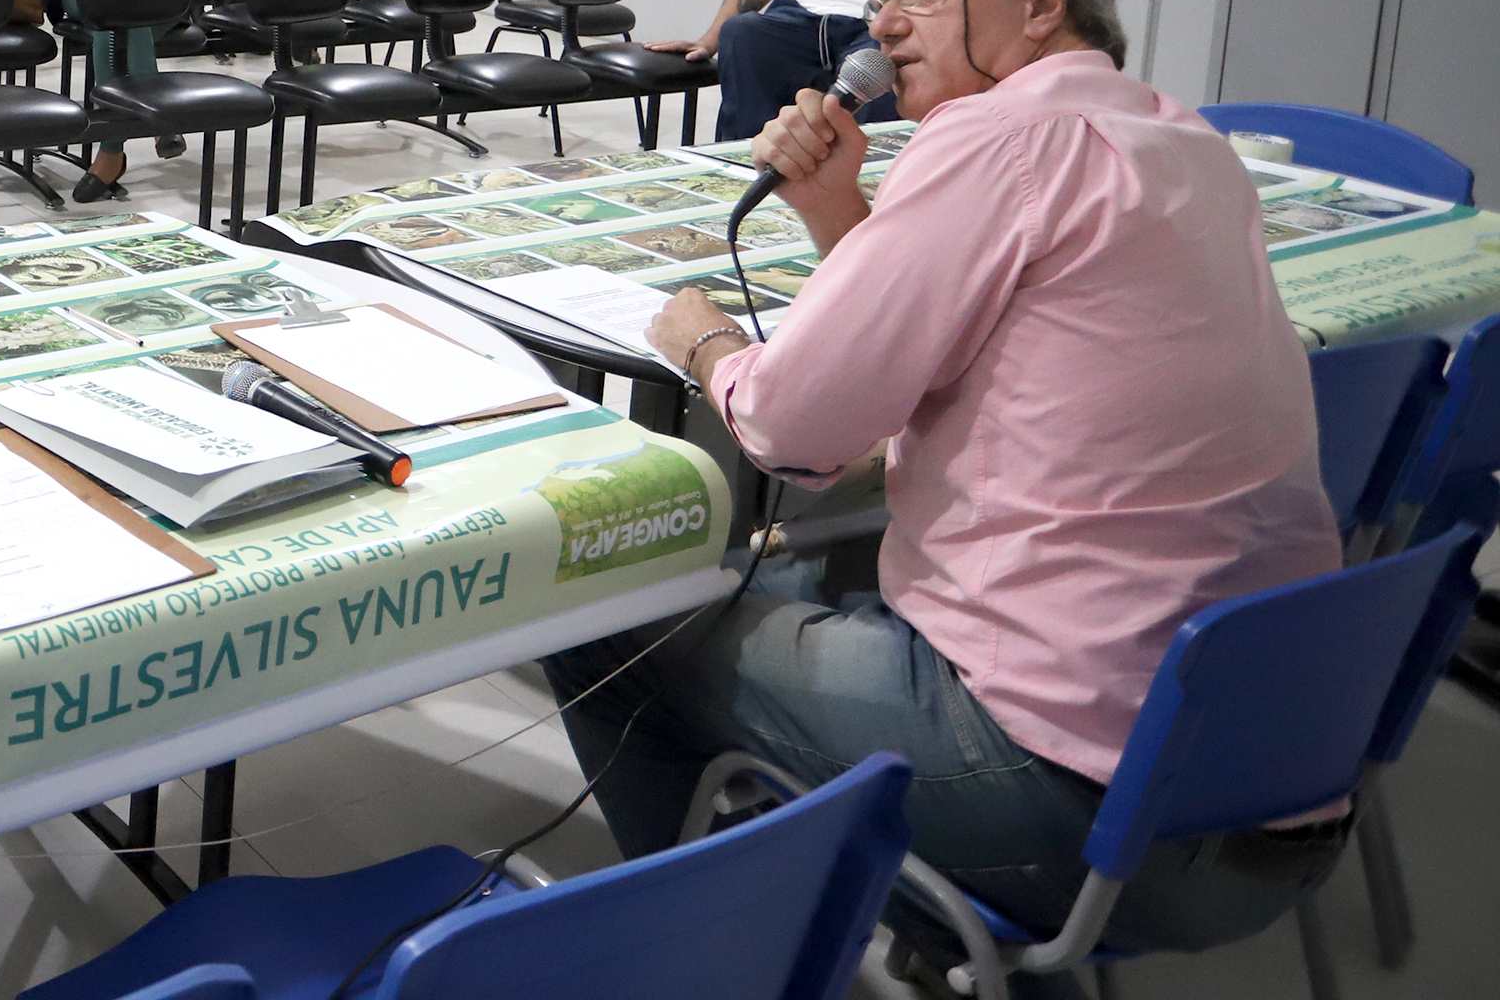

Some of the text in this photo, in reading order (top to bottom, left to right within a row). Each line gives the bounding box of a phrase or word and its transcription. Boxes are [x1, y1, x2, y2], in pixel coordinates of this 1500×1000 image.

[79, 381, 150, 409] AMBIENTAL
[648, 499, 670, 511] Gestor
[673, 490, 701, 504] Conselho
[324, 509, 400, 539] APA
[618, 510, 632, 521] APA
[283, 528, 321, 555] DE
[570, 504, 706, 564] CONGEAPA
[345, 540, 405, 567] ÁREA
[312, 557, 342, 579] DE
[168, 562, 305, 619] PROTEÇÃO
[2, 602, 158, 661] AMBIENTAL
[6, 551, 511, 747] FAUNA SILVESTRE
